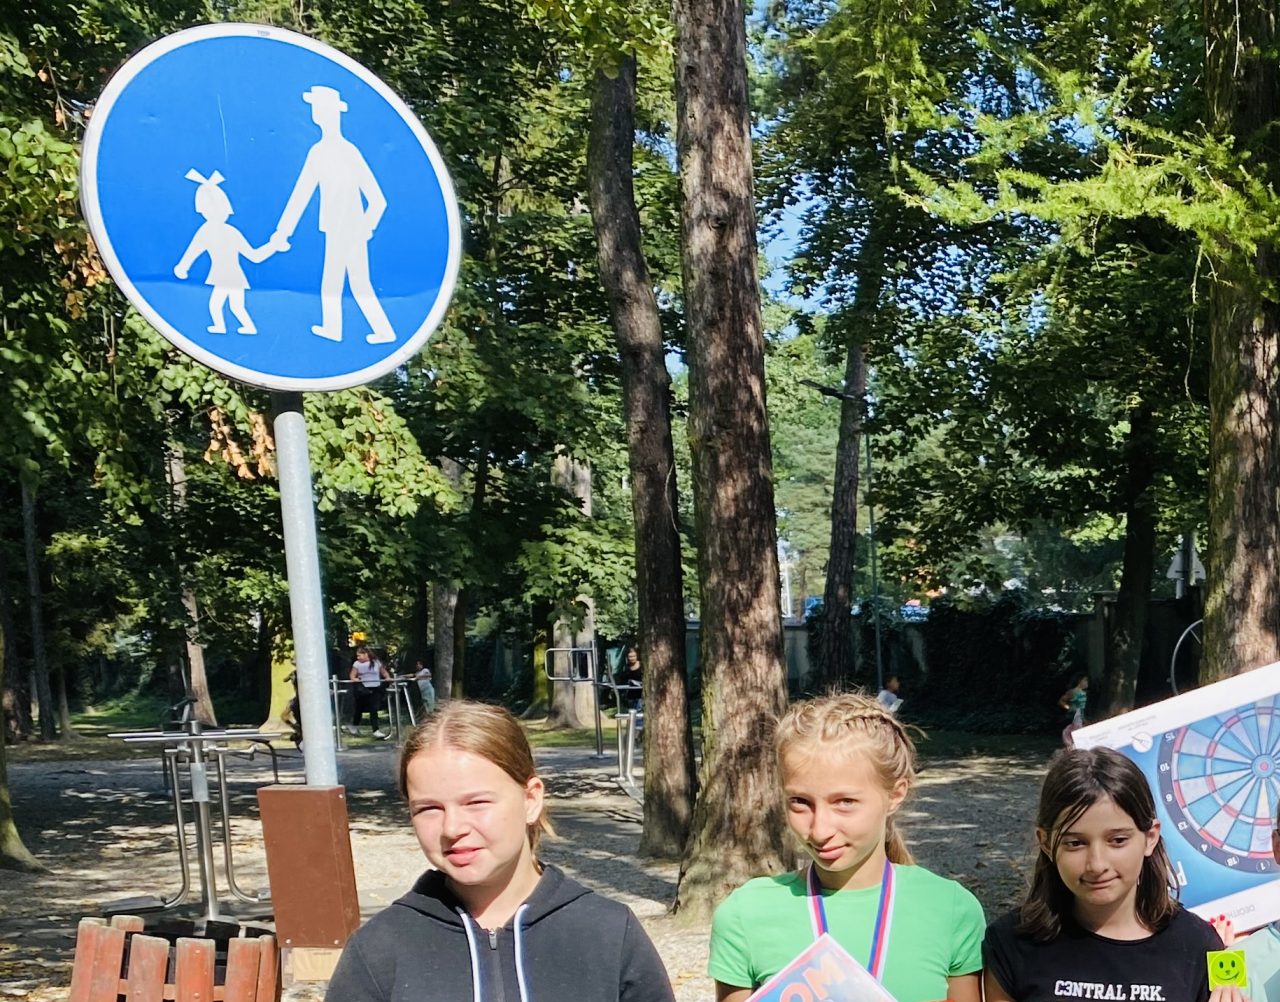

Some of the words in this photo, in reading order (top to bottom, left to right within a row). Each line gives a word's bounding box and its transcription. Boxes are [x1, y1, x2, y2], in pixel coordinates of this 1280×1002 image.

[1165, 733, 1176, 742] 15
[1160, 763, 1170, 772] 10
[1178, 820, 1188, 830] 13
[1227, 856, 1238, 866] 18
[1054, 980, 1127, 1002] C3NTRAL
[1130, 985, 1166, 1002] PRK.
